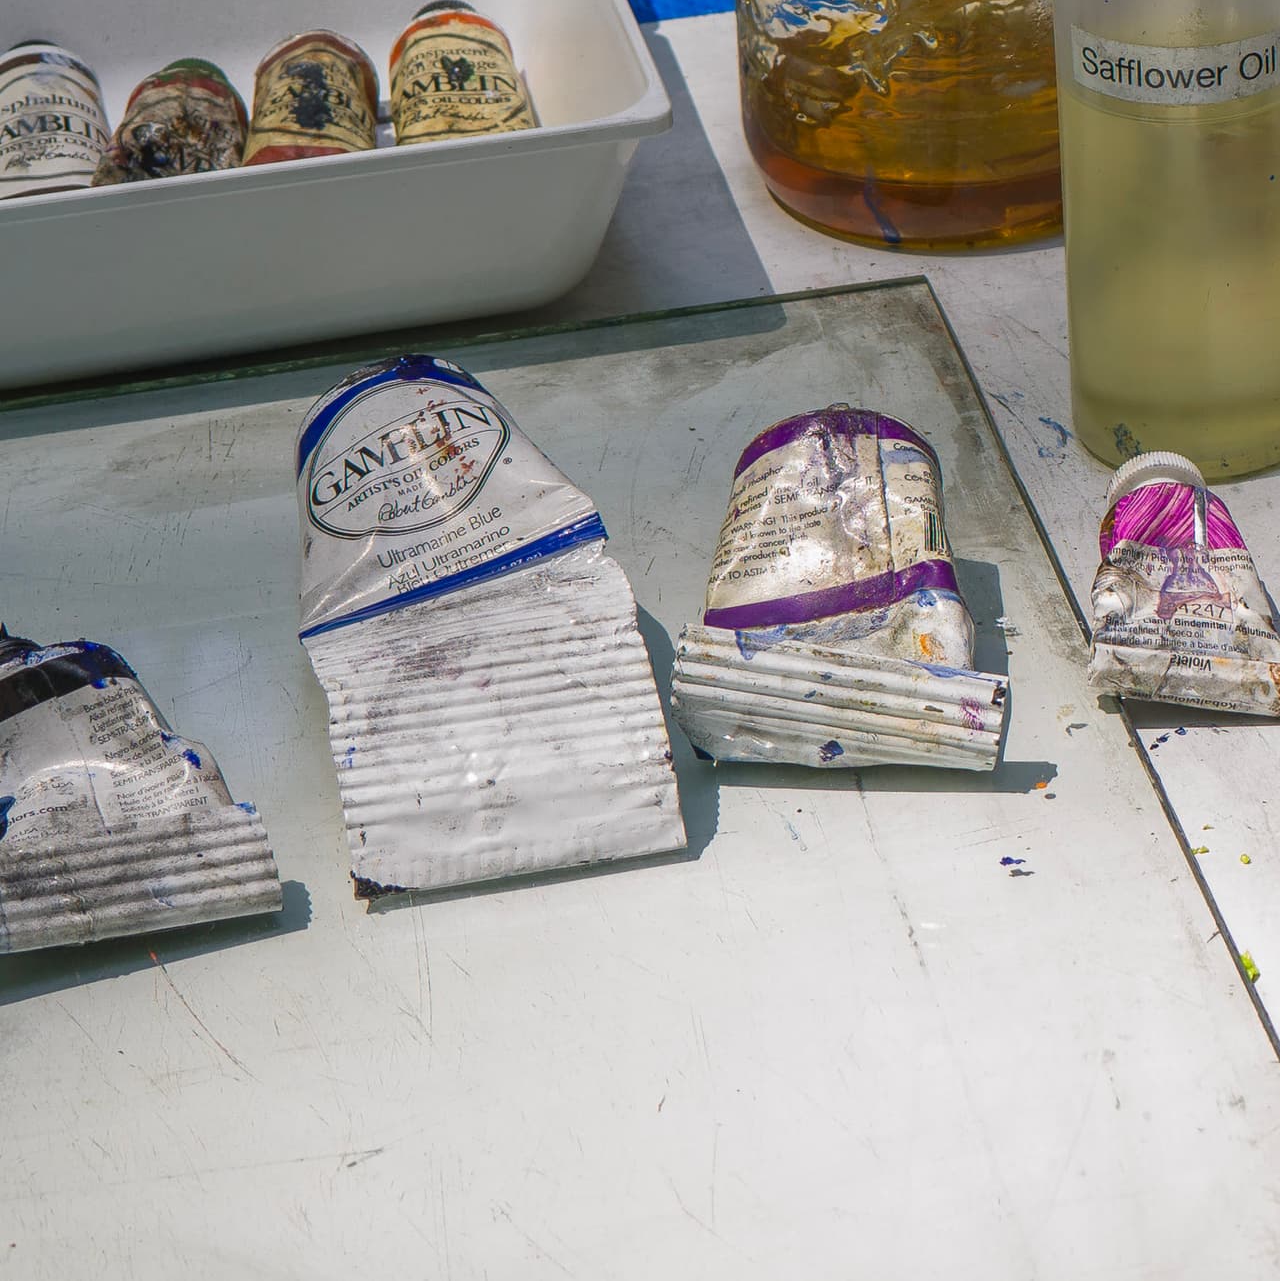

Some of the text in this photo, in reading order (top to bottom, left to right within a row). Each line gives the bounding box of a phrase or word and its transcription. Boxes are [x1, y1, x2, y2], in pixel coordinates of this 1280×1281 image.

[1081, 45, 1276, 89] Safflower Oil
[347, 477, 401, 511] ARTIST'S
[428, 437, 480, 472] COLORS
[398, 483, 424, 496] MADE
[376, 525, 467, 569] Ultramarine
[469, 505, 502, 531] Blue
[388, 560, 420, 589] Azul
[423, 526, 510, 572] Ultramarino
[729, 571, 741, 580] TO
[1197, 641, 1219, 650] base
